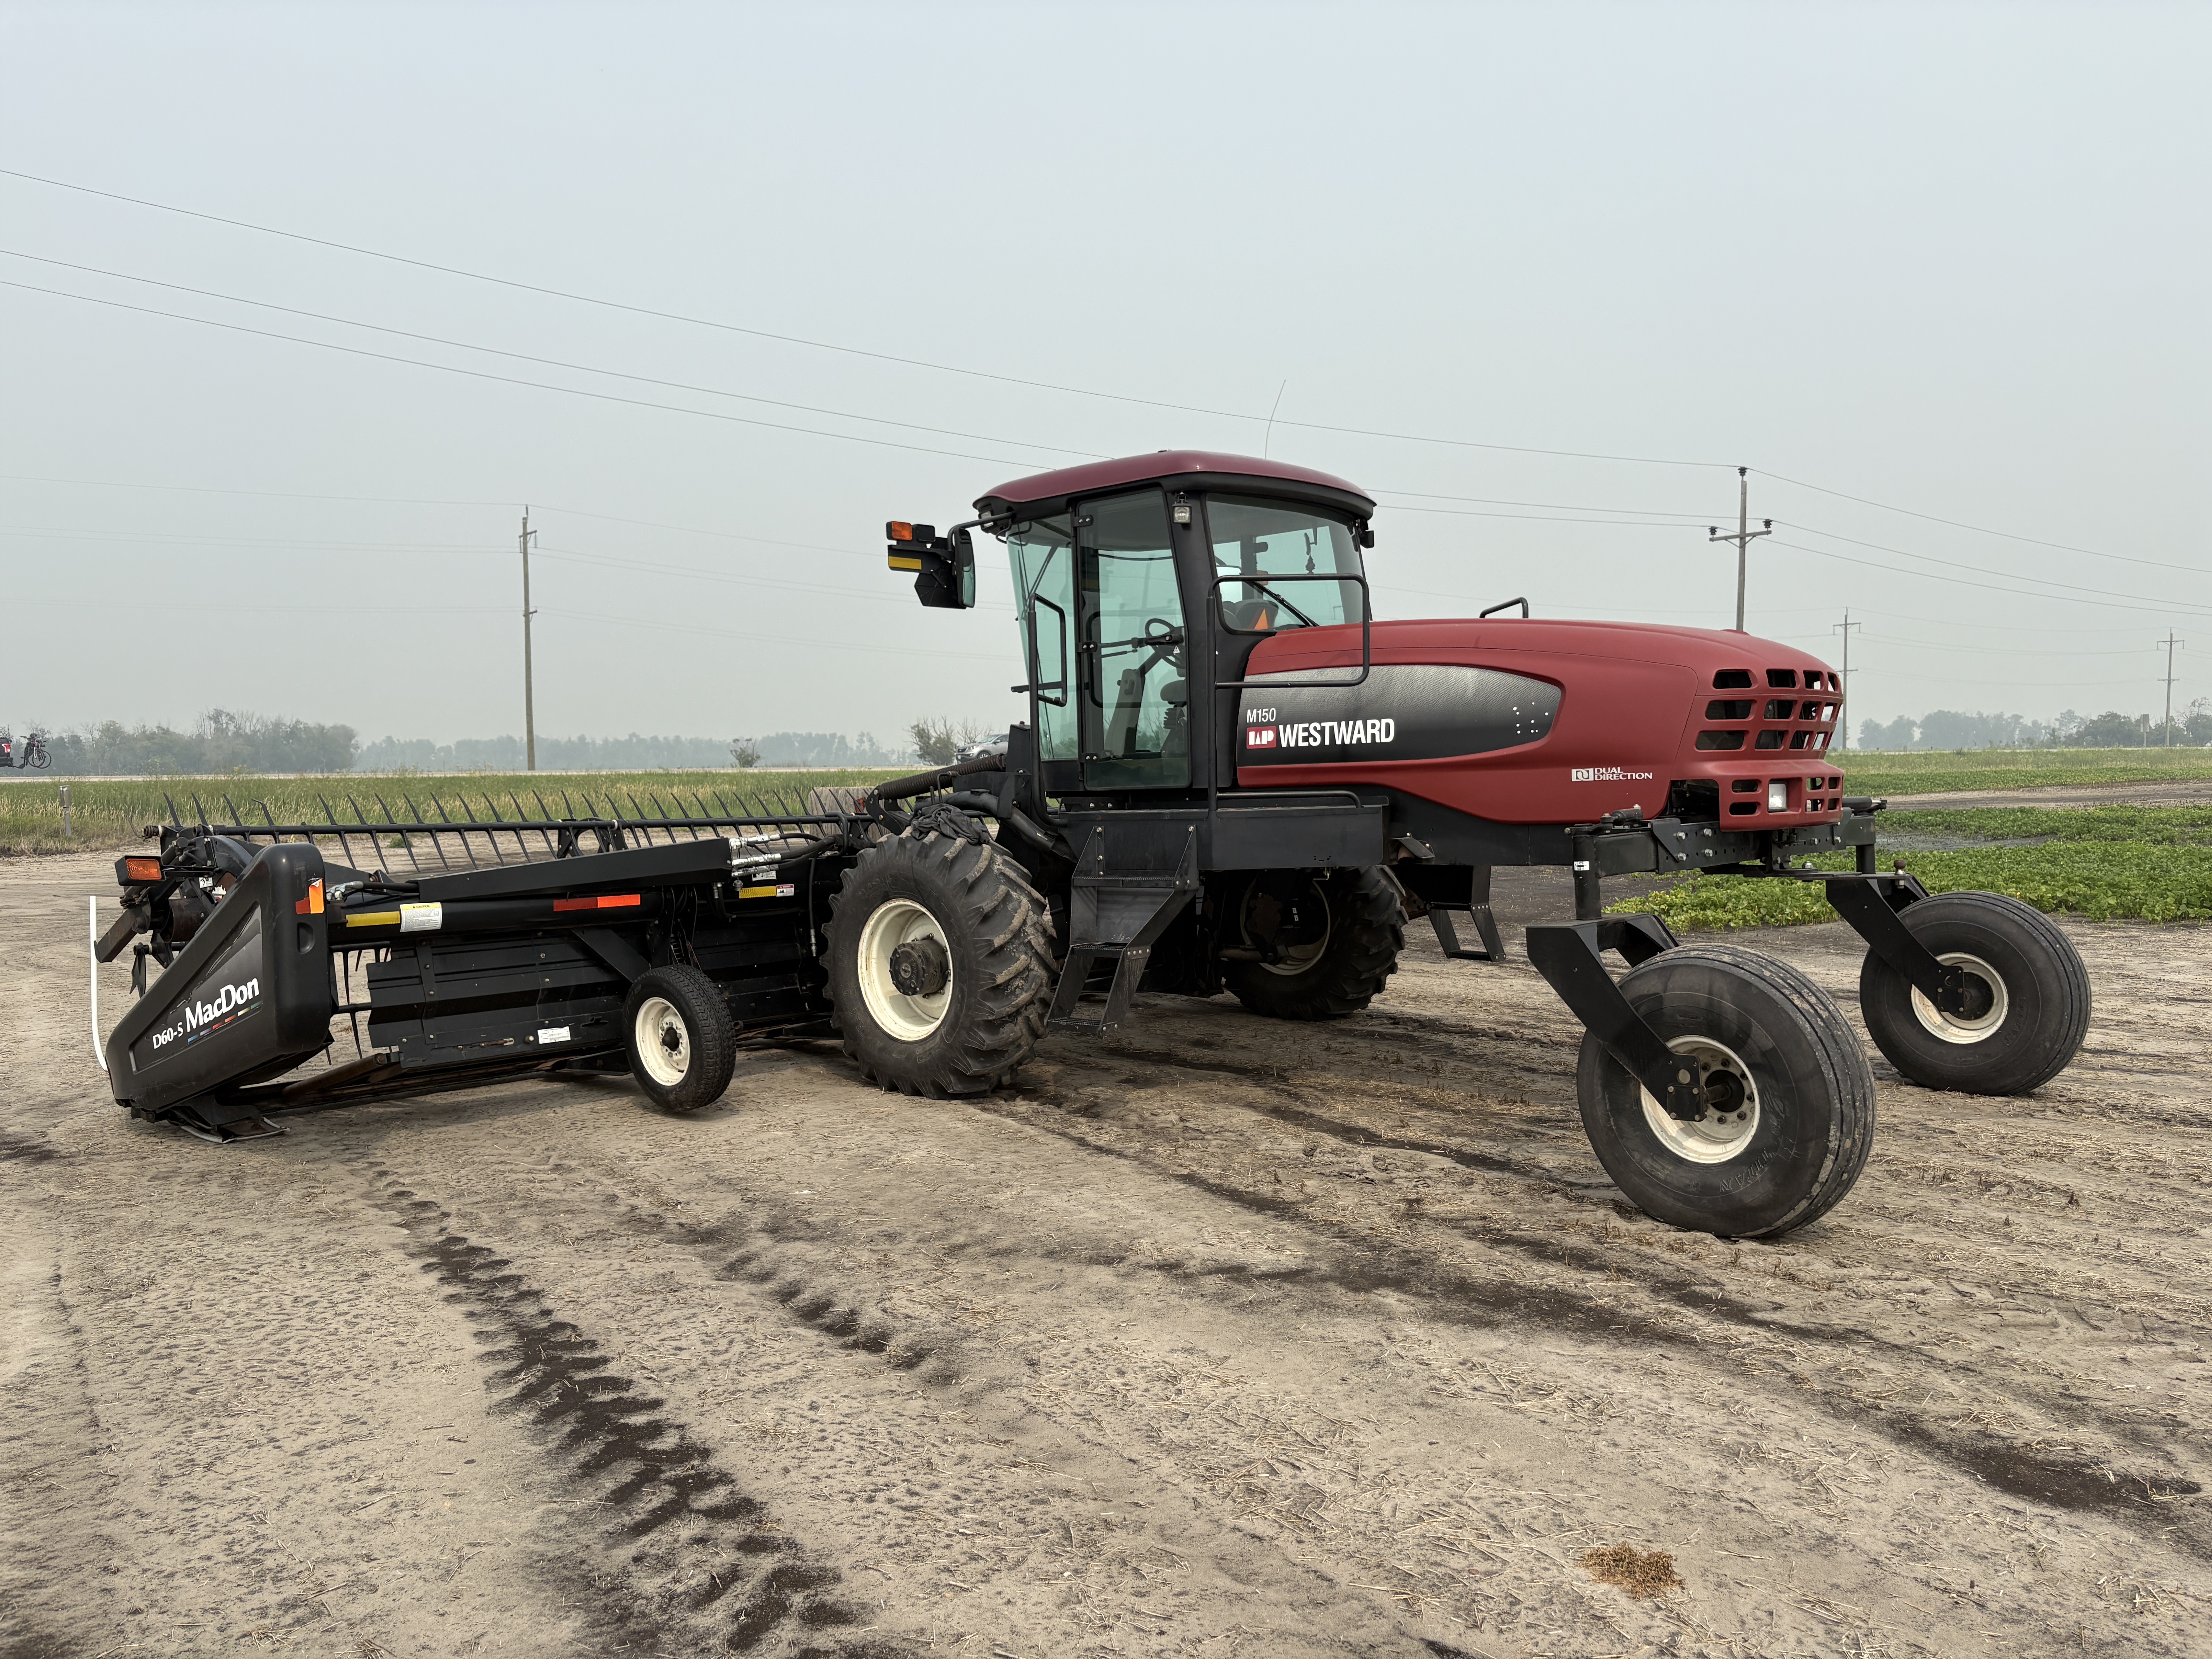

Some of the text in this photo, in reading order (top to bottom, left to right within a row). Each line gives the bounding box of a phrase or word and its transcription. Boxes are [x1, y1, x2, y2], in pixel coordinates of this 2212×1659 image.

[1247, 708, 1276, 723] M150
[1278, 718, 1395, 747] WESTWARD
[1595, 772, 1652, 781] DIRECTION
[152, 977, 259, 1049] D60-S MacDon
